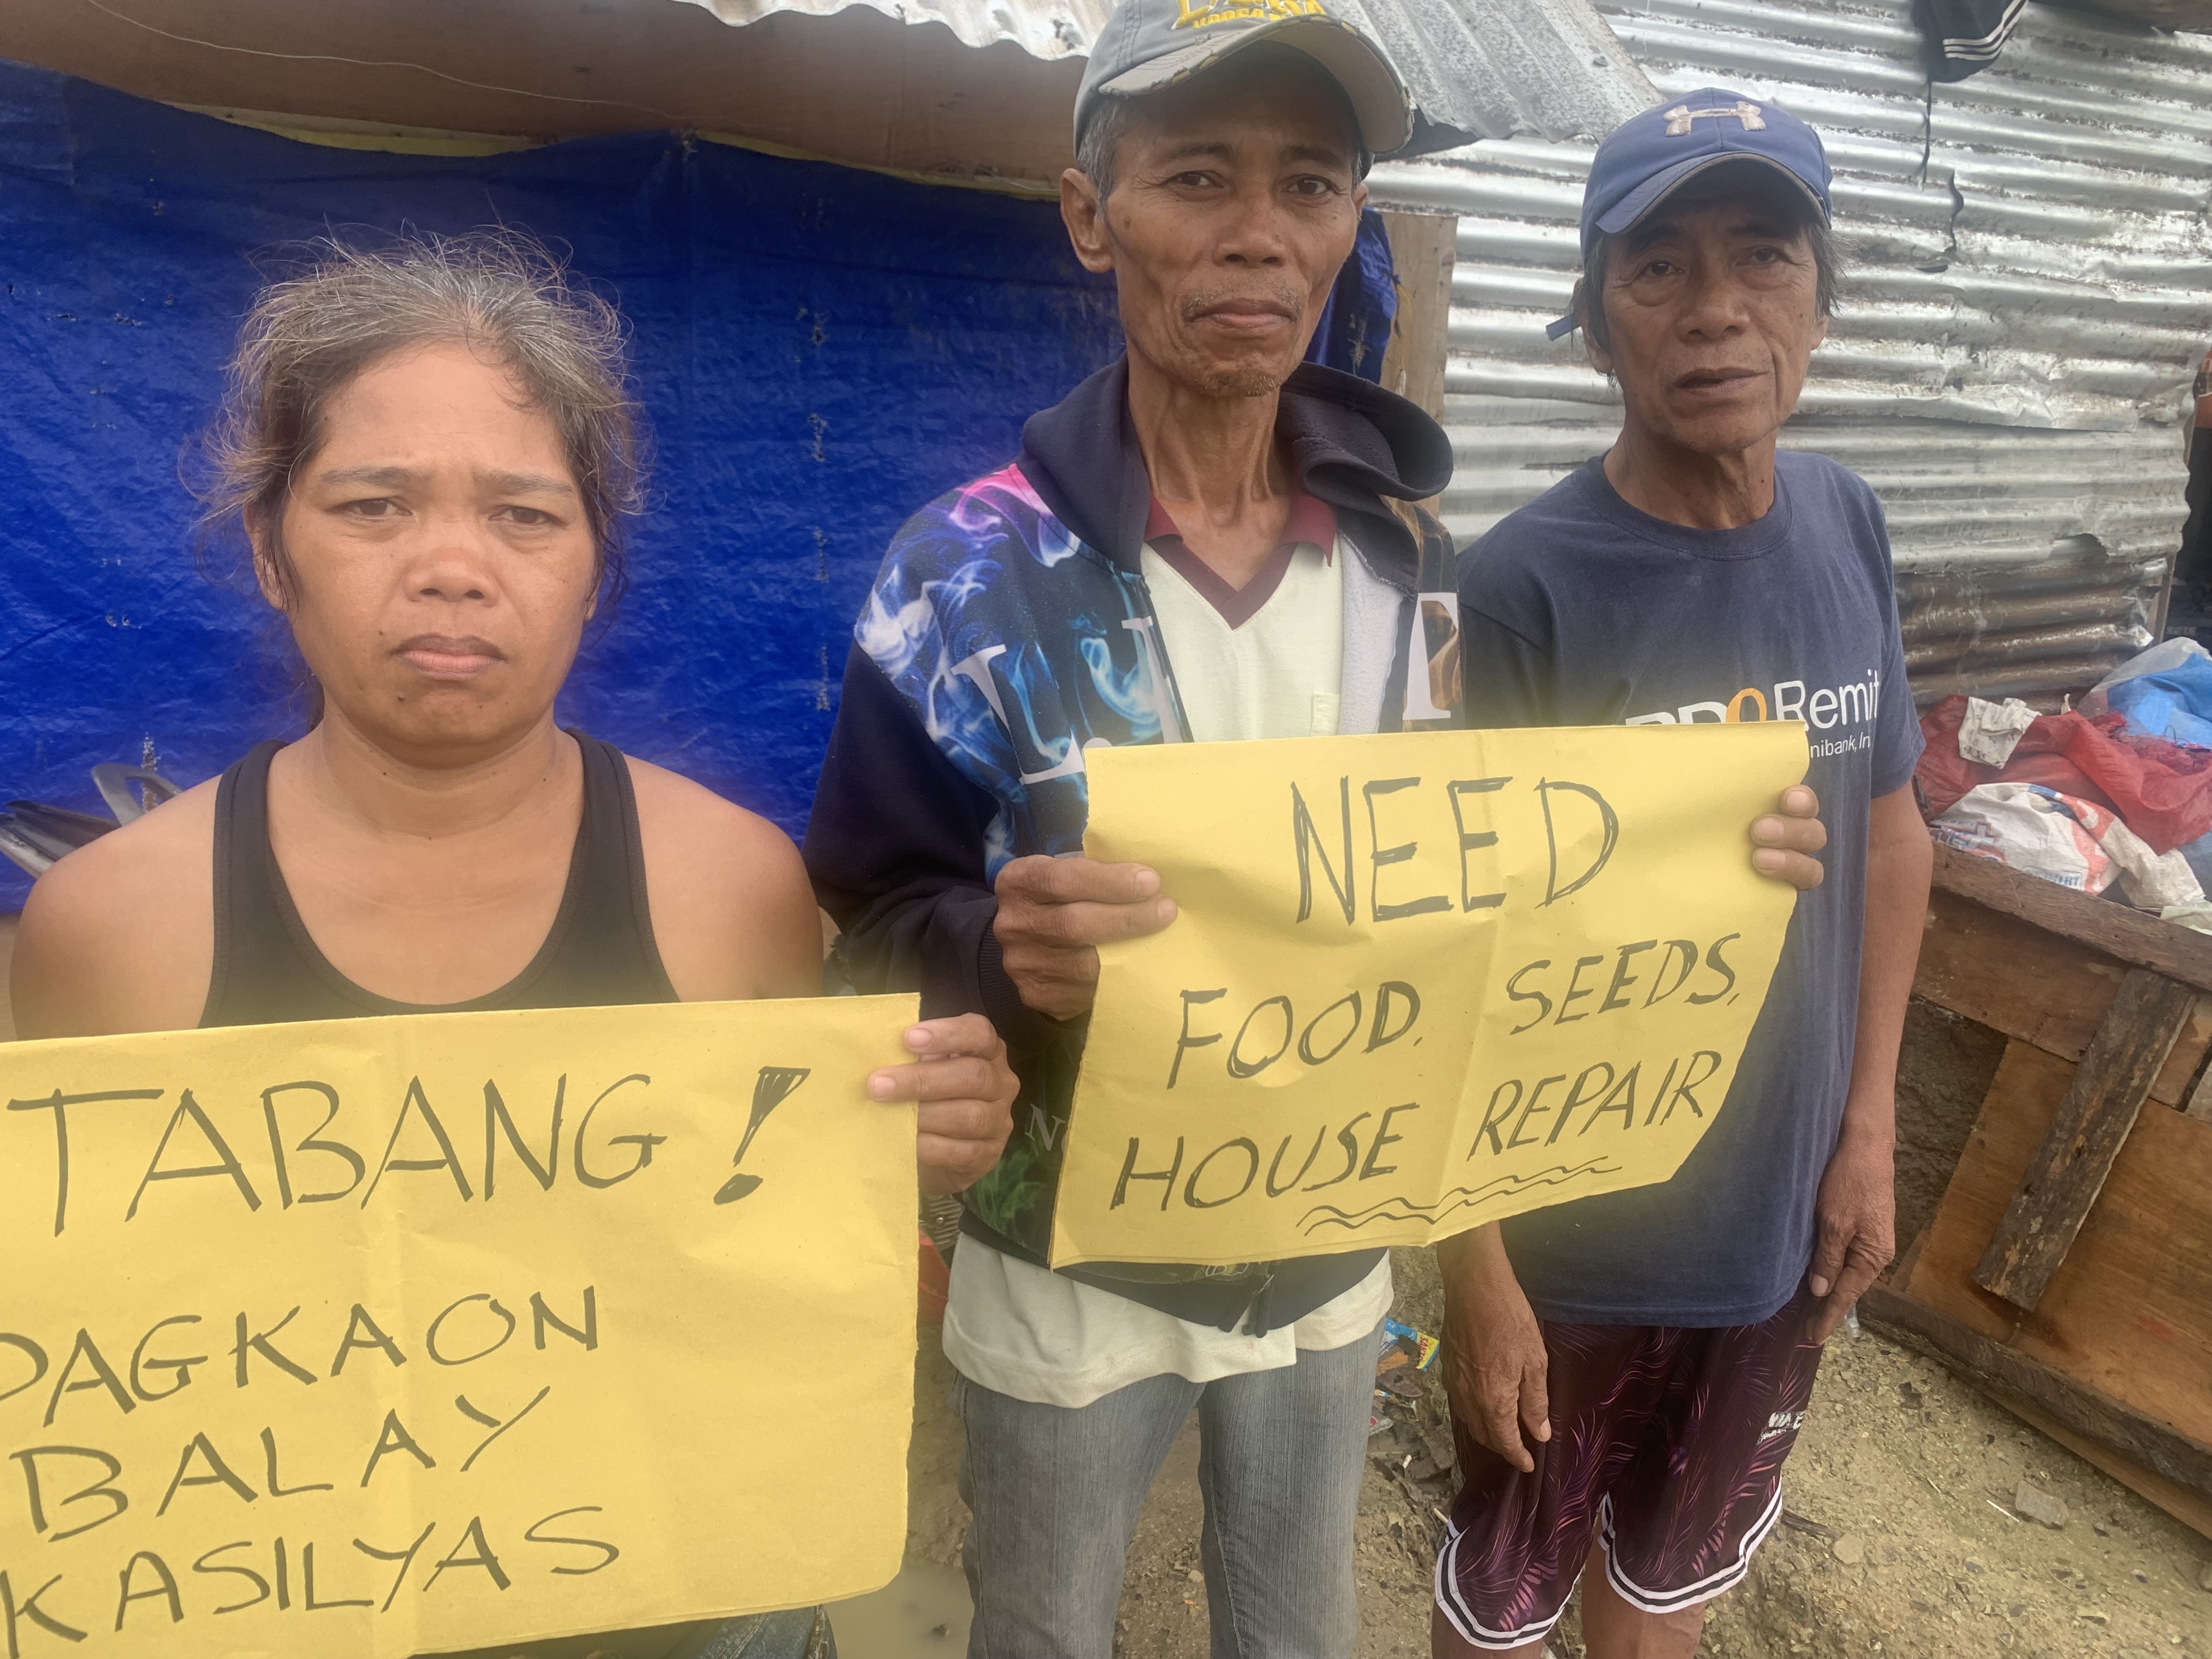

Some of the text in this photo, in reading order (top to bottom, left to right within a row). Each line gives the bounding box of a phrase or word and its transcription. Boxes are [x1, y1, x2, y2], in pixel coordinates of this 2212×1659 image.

[1810, 735, 1857, 758] nibank,
[1290, 775, 1619, 925] NEED
[1109, 1050, 1722, 1211] HOUSE REPAIR
[8, 1385, 551, 1543] BALAY
[0, 1506, 619, 1659] KASILYAS
